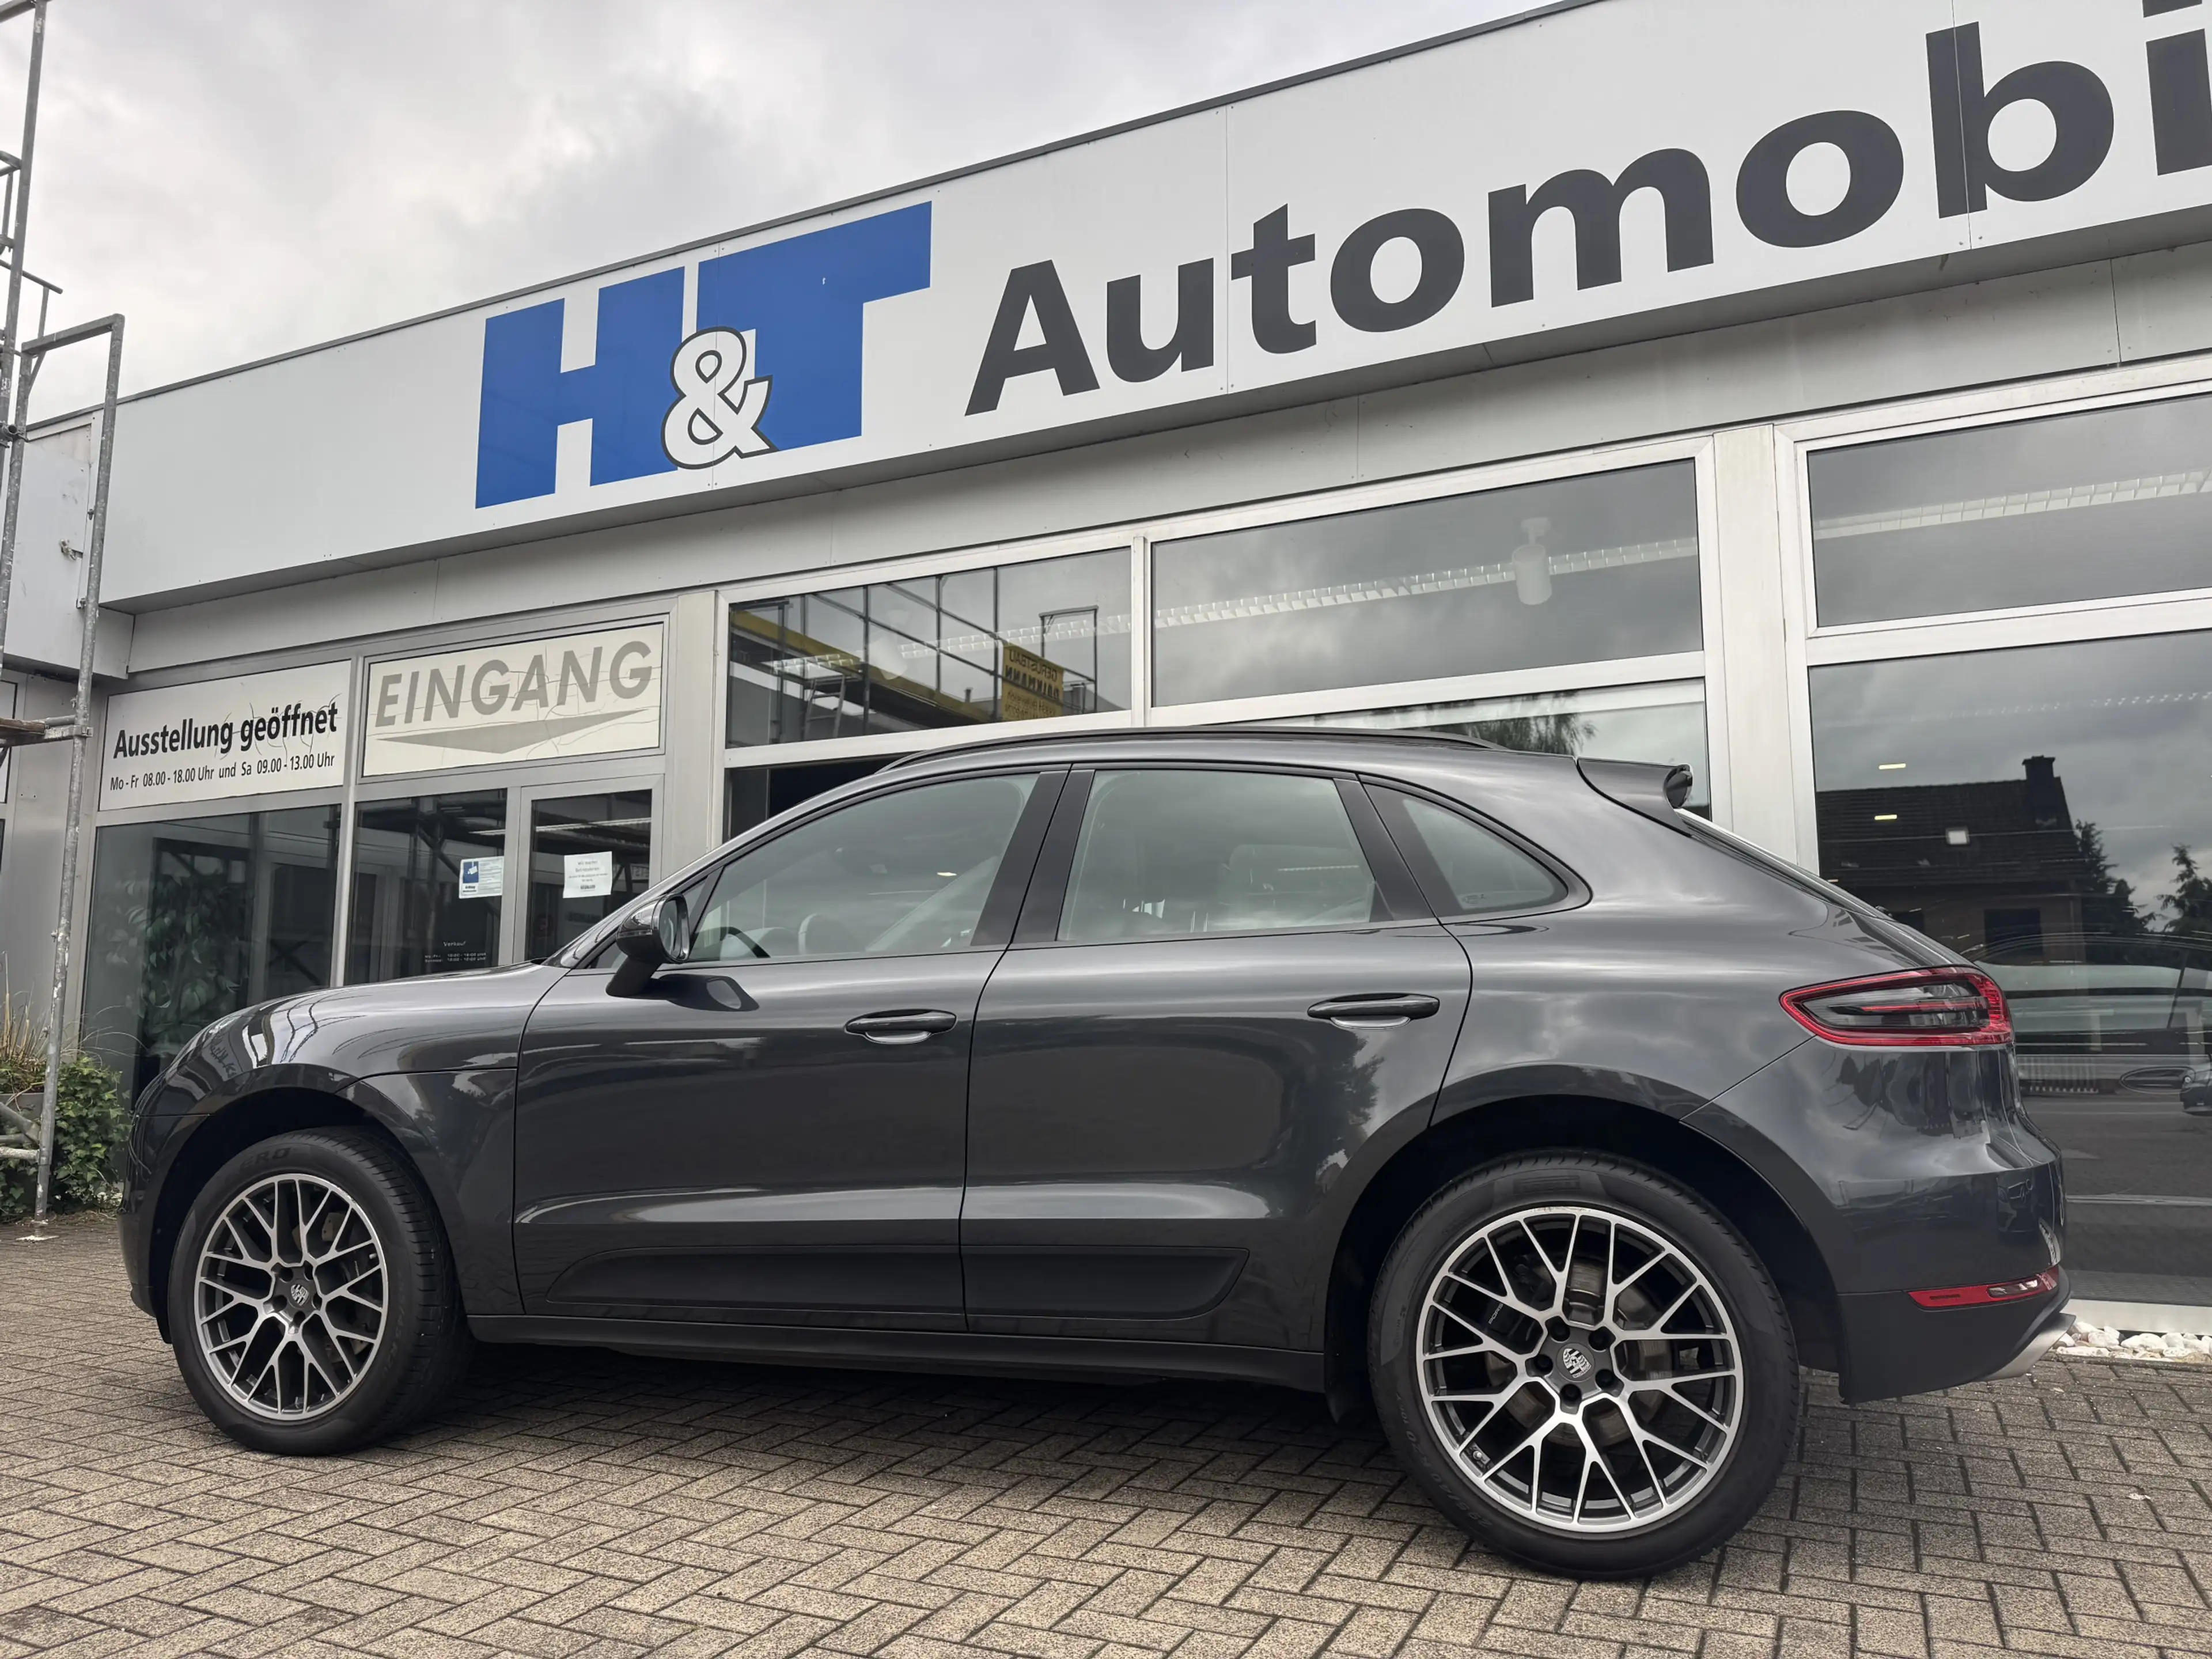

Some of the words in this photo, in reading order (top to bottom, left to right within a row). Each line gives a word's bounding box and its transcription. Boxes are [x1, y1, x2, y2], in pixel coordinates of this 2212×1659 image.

[475, 201, 932, 509] H&T
[965, 0, 2212, 416] Automobi
[375, 641, 653, 728] EINGANG
[113, 718, 233, 759] Ausstellung
[240, 702, 338, 752] geöffnet
[198, 765, 214, 781] Uhr
[219, 763, 236, 778] und
[241, 762, 252, 776] Sa
[317, 752, 335, 767] Uhr
